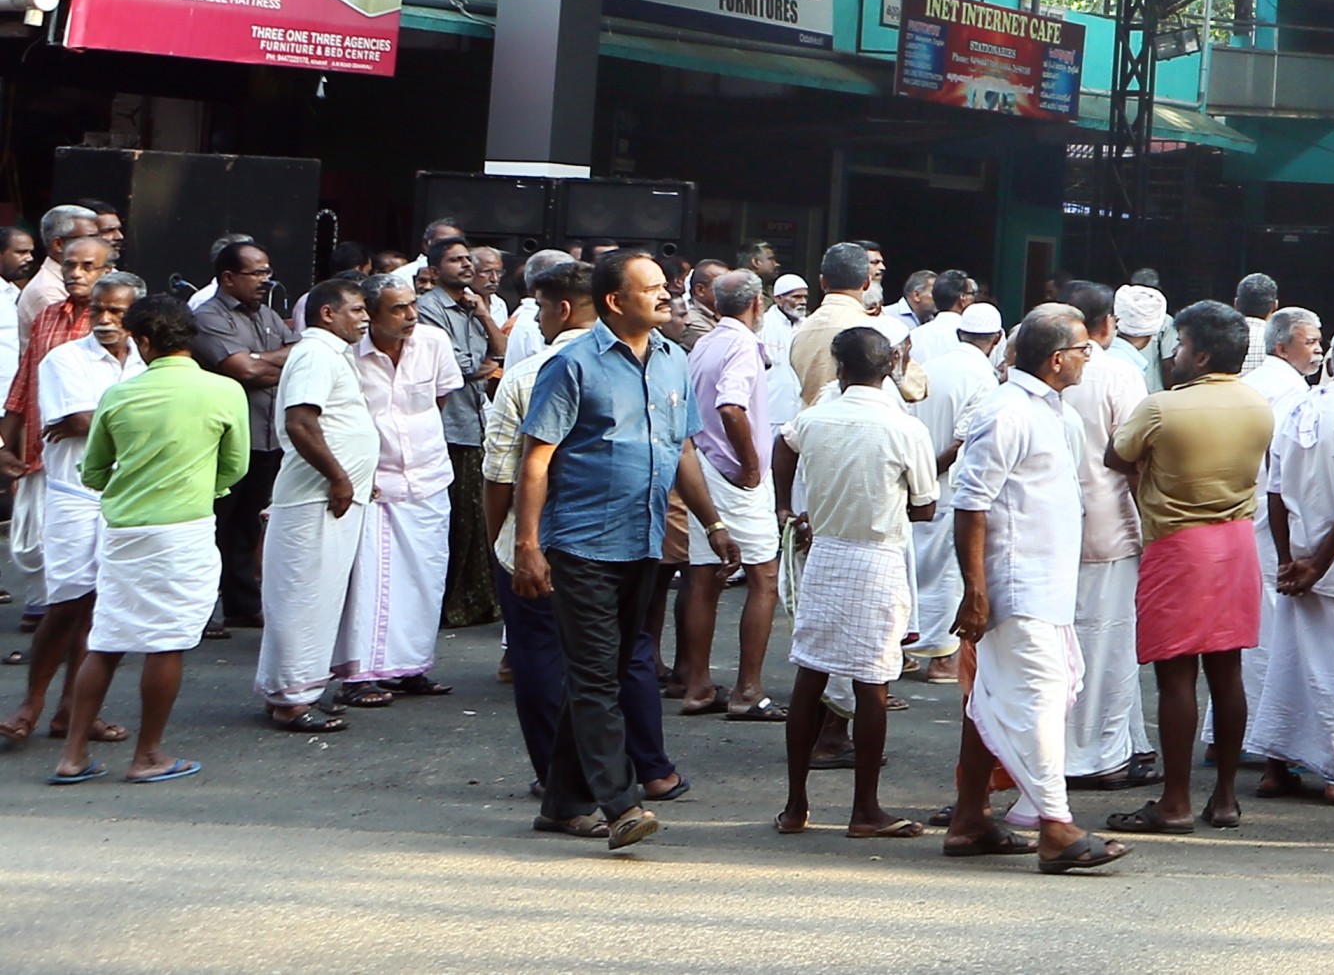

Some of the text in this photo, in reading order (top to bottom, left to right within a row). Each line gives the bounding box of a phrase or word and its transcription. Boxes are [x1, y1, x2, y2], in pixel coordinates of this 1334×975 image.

[961, 1, 1028, 38] INTERNET
[1029, 18, 1062, 44] CAFE
[251, 26, 392, 52] THREE ONE THREE AGENCIES
[260, 40, 381, 62] FURNITURE & BED CENTRE
